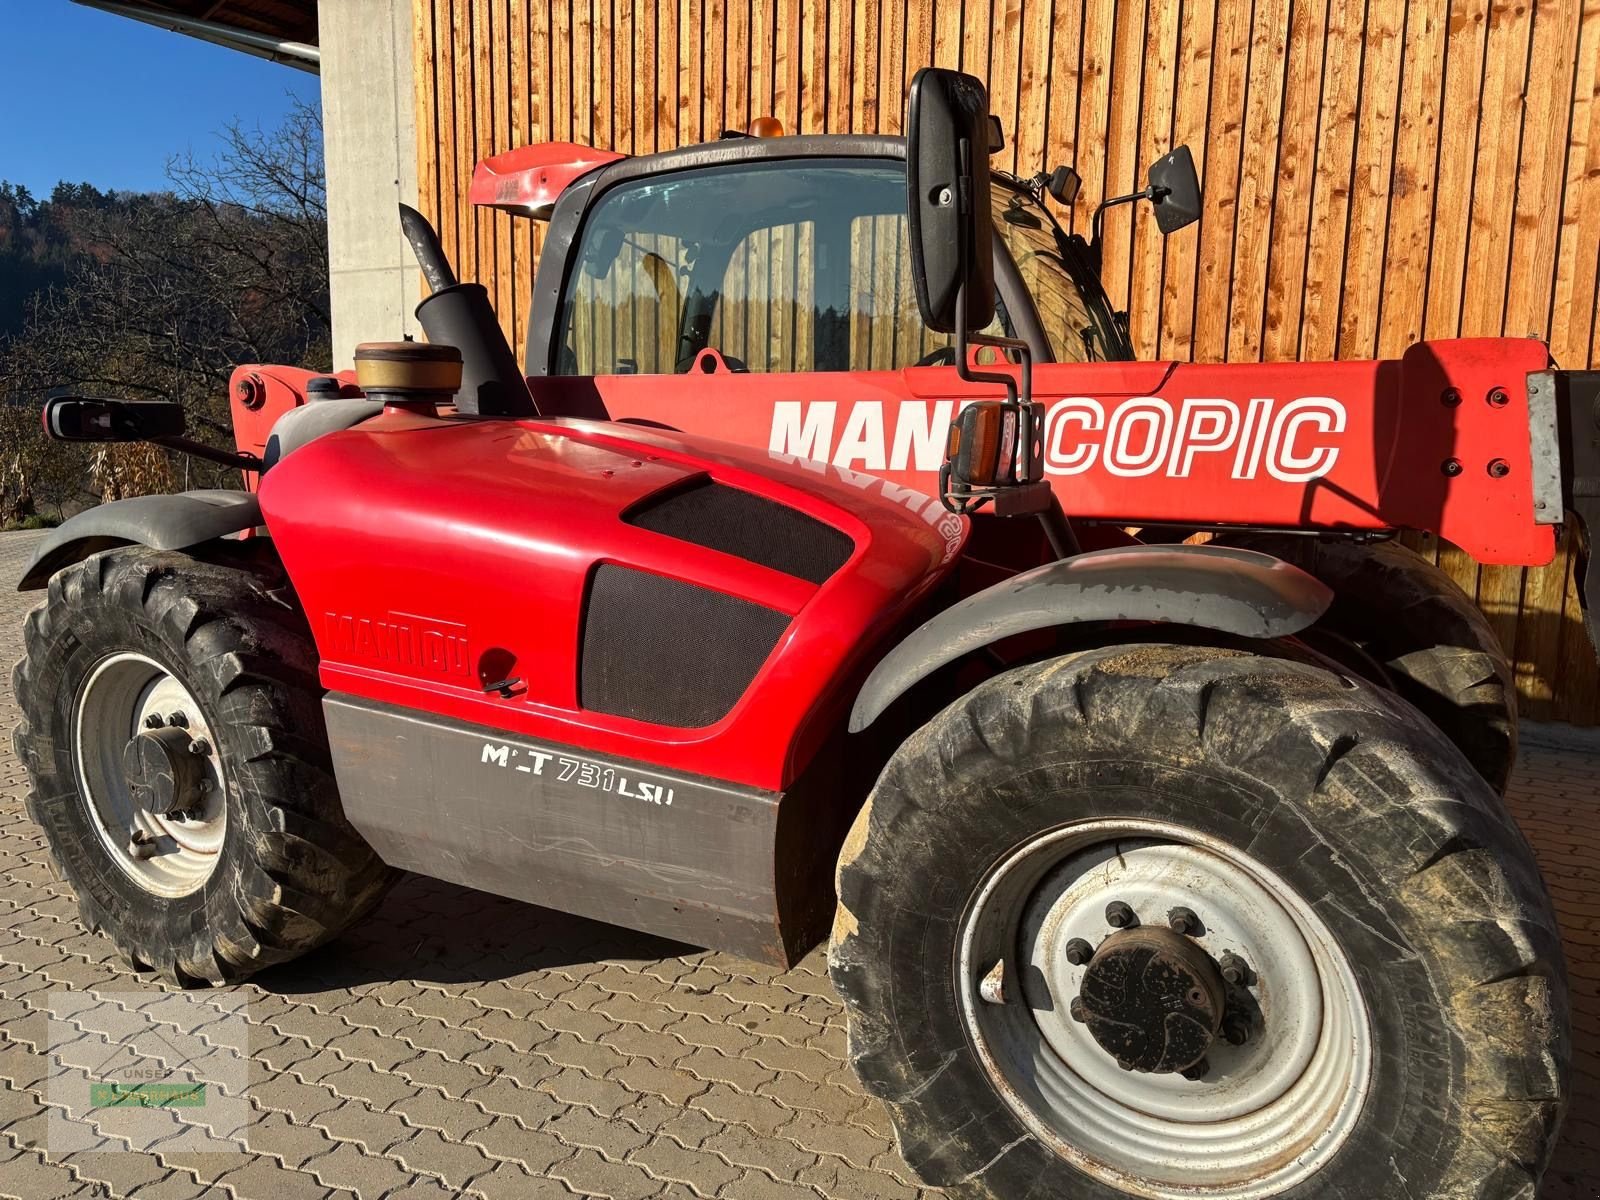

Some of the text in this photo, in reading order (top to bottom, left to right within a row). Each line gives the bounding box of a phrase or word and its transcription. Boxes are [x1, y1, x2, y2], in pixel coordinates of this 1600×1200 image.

[768, 398, 1347, 482] MANCOPIC
[325, 609, 472, 677] MANITOU
[556, 757, 615, 793] 731
